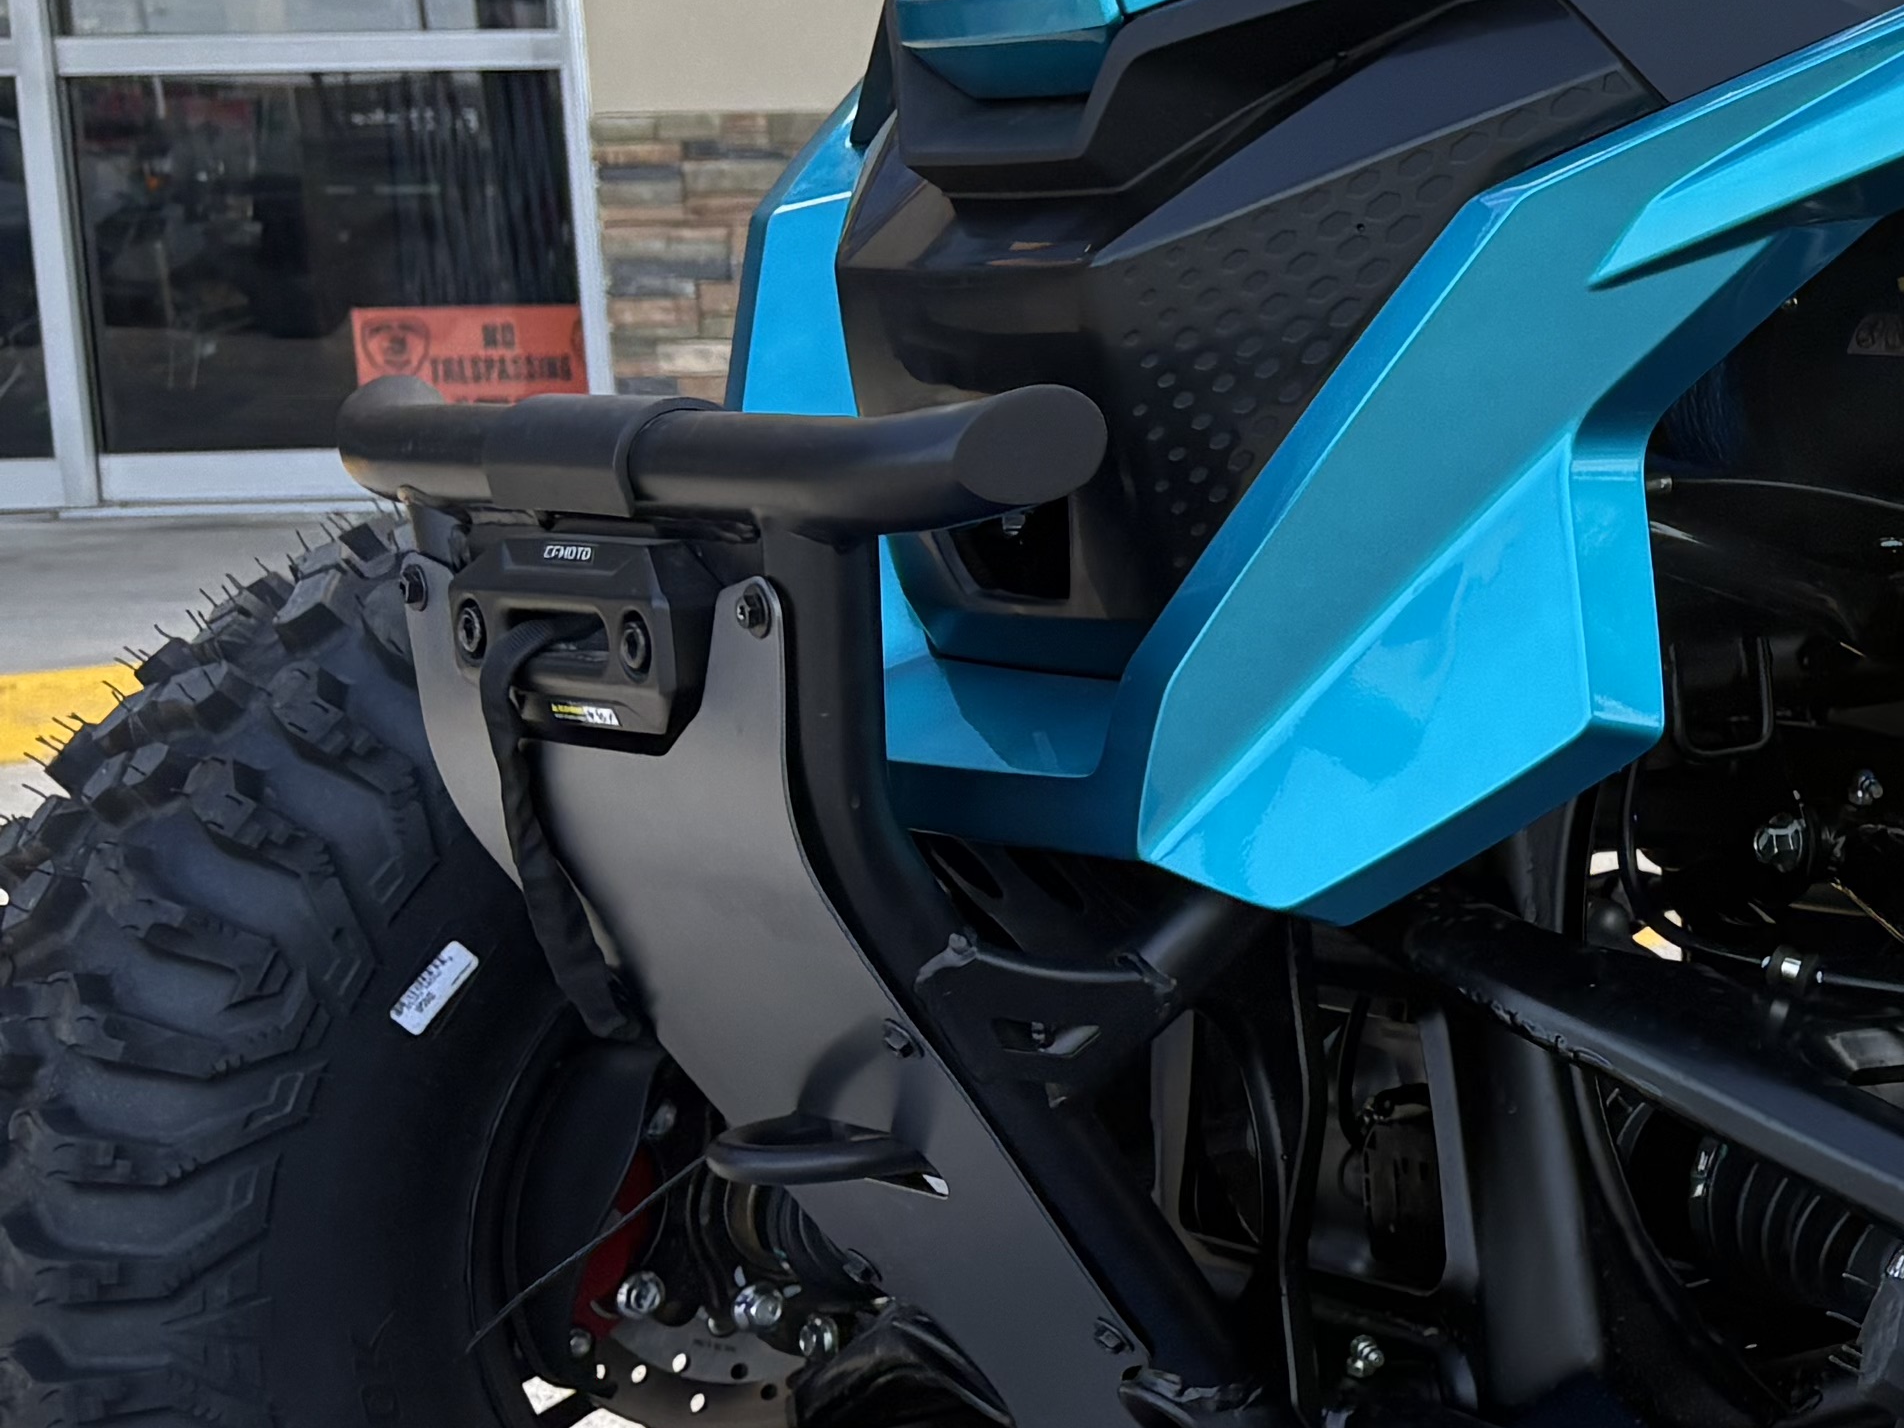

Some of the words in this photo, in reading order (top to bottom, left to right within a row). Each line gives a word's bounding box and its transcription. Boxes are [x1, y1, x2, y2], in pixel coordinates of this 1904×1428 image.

[482, 322, 516, 350] NO
[431, 354, 572, 383] TRESPASSING
[543, 544, 593, 562] CFMOTO
